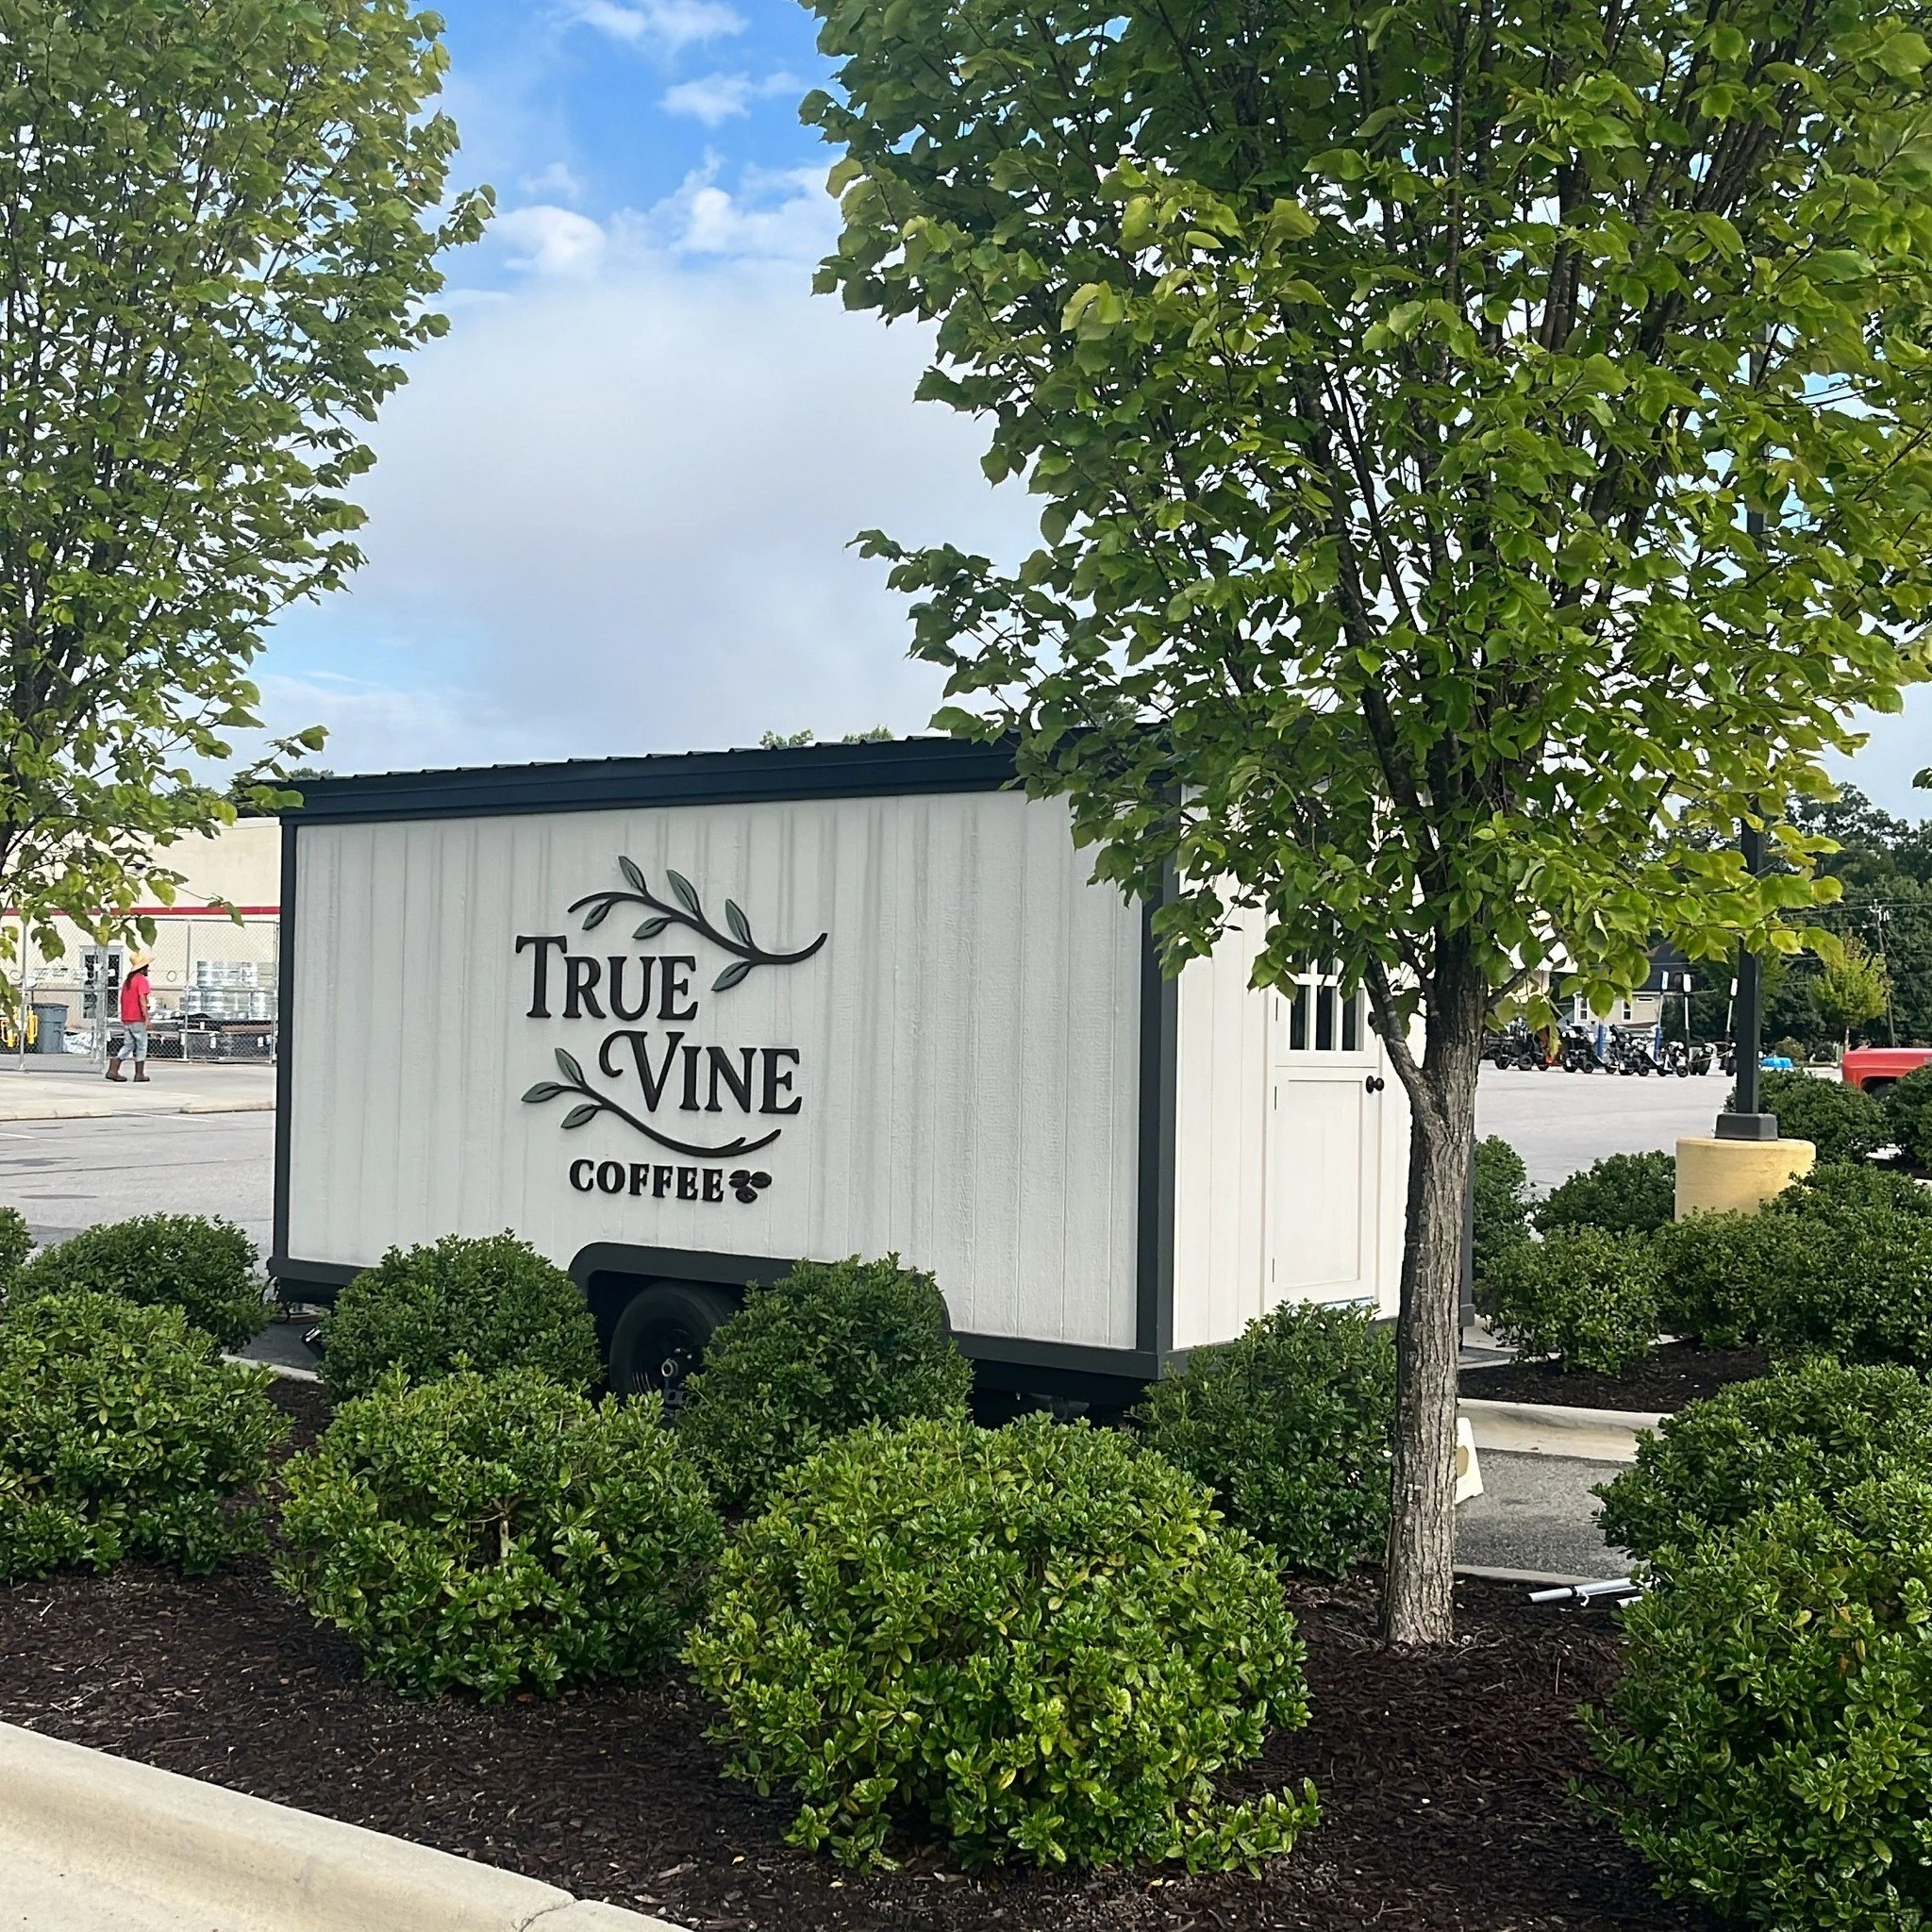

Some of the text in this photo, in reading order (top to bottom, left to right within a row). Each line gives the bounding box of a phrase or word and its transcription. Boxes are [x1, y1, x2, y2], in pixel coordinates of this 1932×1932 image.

[515, 935, 699, 1021] TRUE
[599, 1030, 802, 1114] VINE
[569, 1158, 724, 1203] COFFEE
